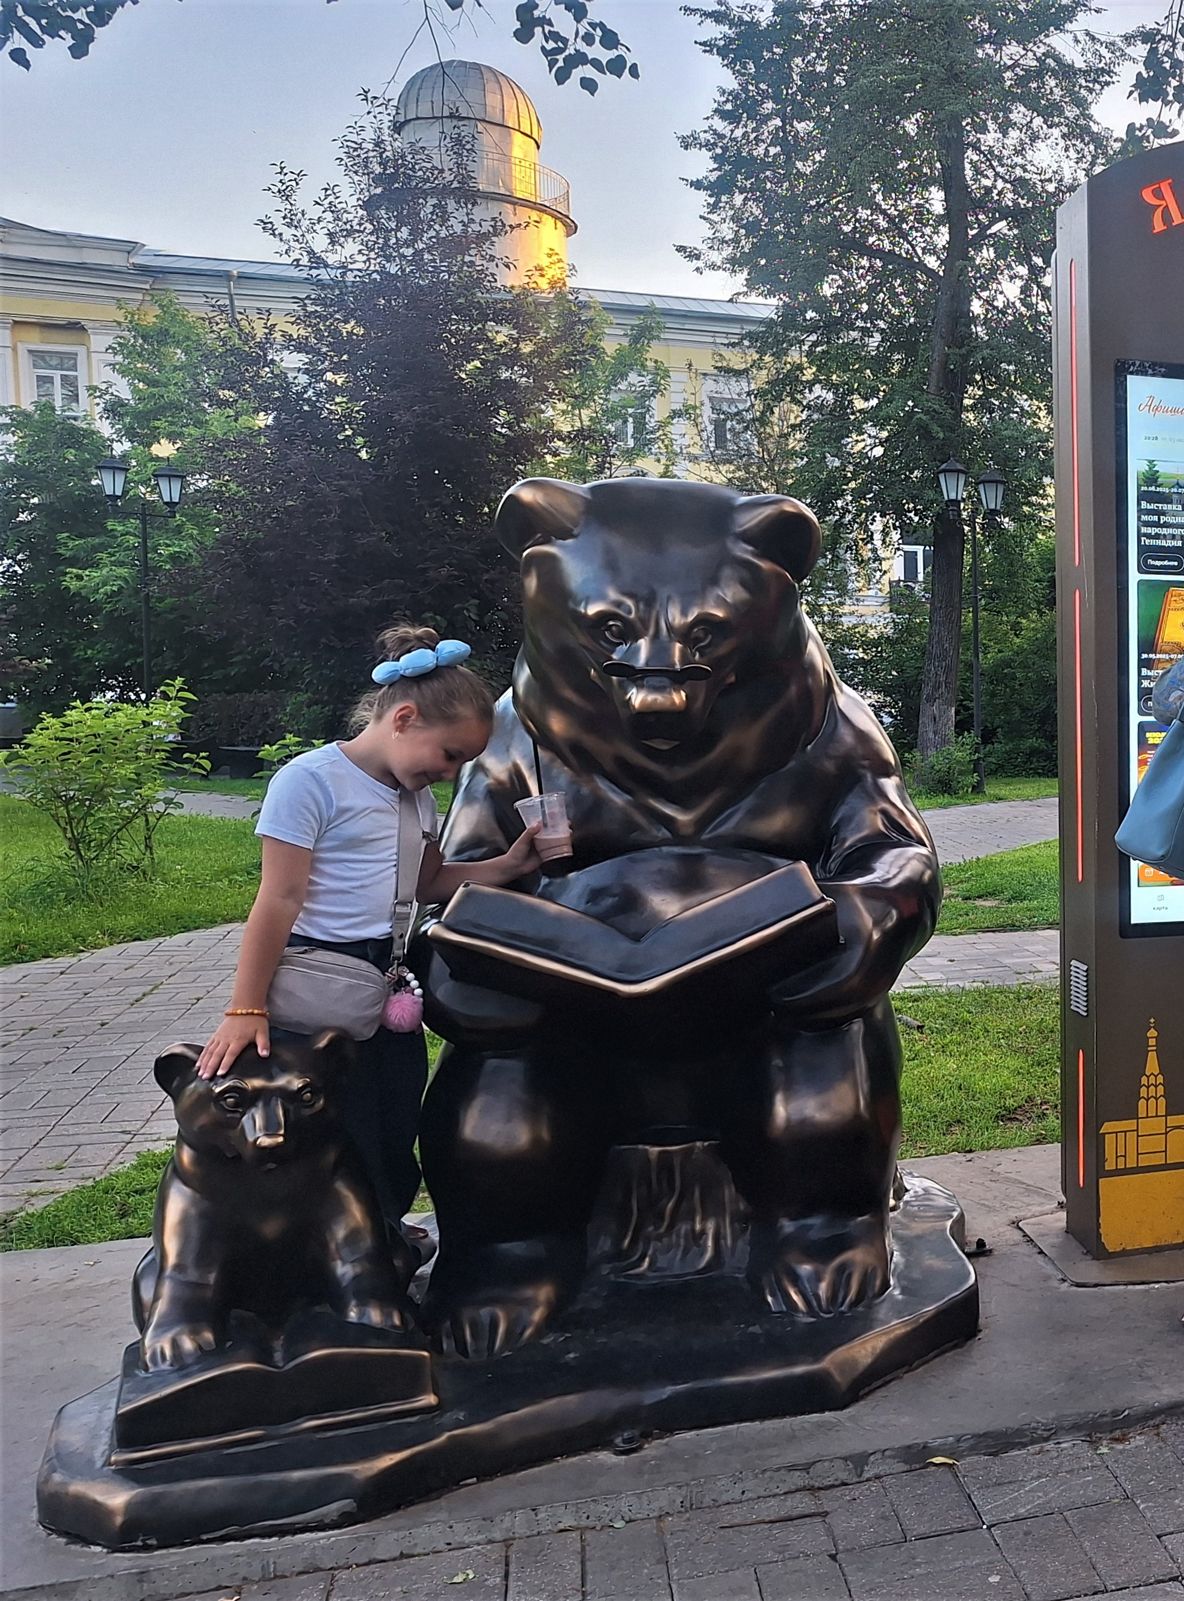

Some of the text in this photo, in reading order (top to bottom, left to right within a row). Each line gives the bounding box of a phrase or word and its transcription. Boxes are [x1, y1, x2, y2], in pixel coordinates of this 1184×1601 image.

[1140, 500, 1182, 511] Выставка
[1140, 514, 1159, 523] моя
[1140, 536, 1183, 548] Геннадия
[1147, 558, 1179, 567] Подробнее
